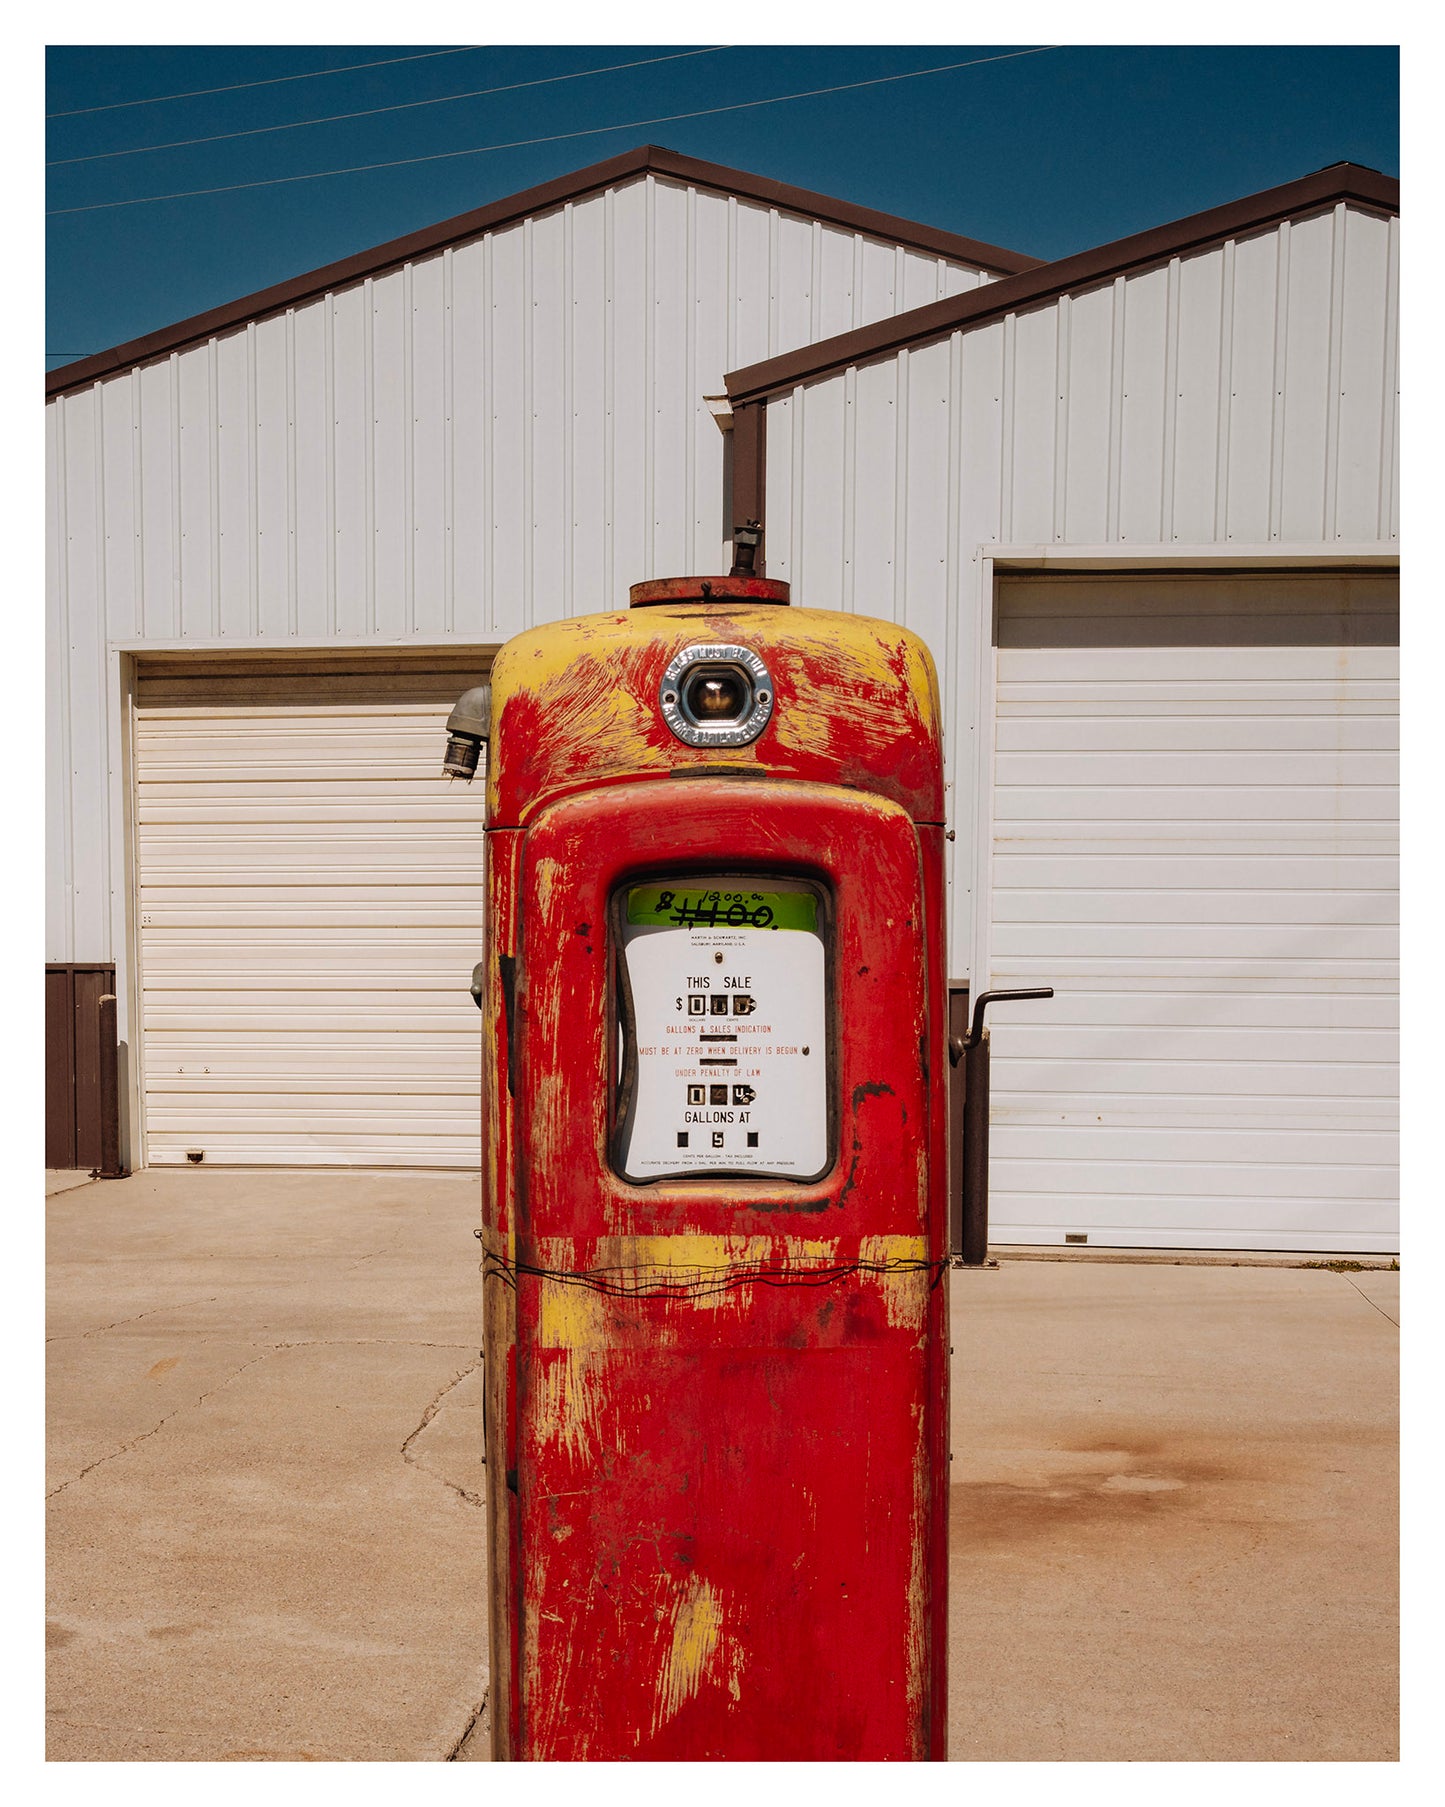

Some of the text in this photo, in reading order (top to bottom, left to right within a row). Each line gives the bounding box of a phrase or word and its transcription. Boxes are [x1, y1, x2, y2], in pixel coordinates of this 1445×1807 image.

[698, 648, 727, 659] MUST
[731, 648, 744, 660] BE
[686, 976, 752, 989] THIS SALE
[666, 1025, 772, 1034] GALLONS & SALES INDICATION
[639, 1047, 798, 1055] MUST BE AT ZERO WHEN DELIVERY IS BEGUN
[675, 1069, 761, 1078] UNDER PENALTY OF LAW
[685, 1111, 751, 1123] GALLONS AT
